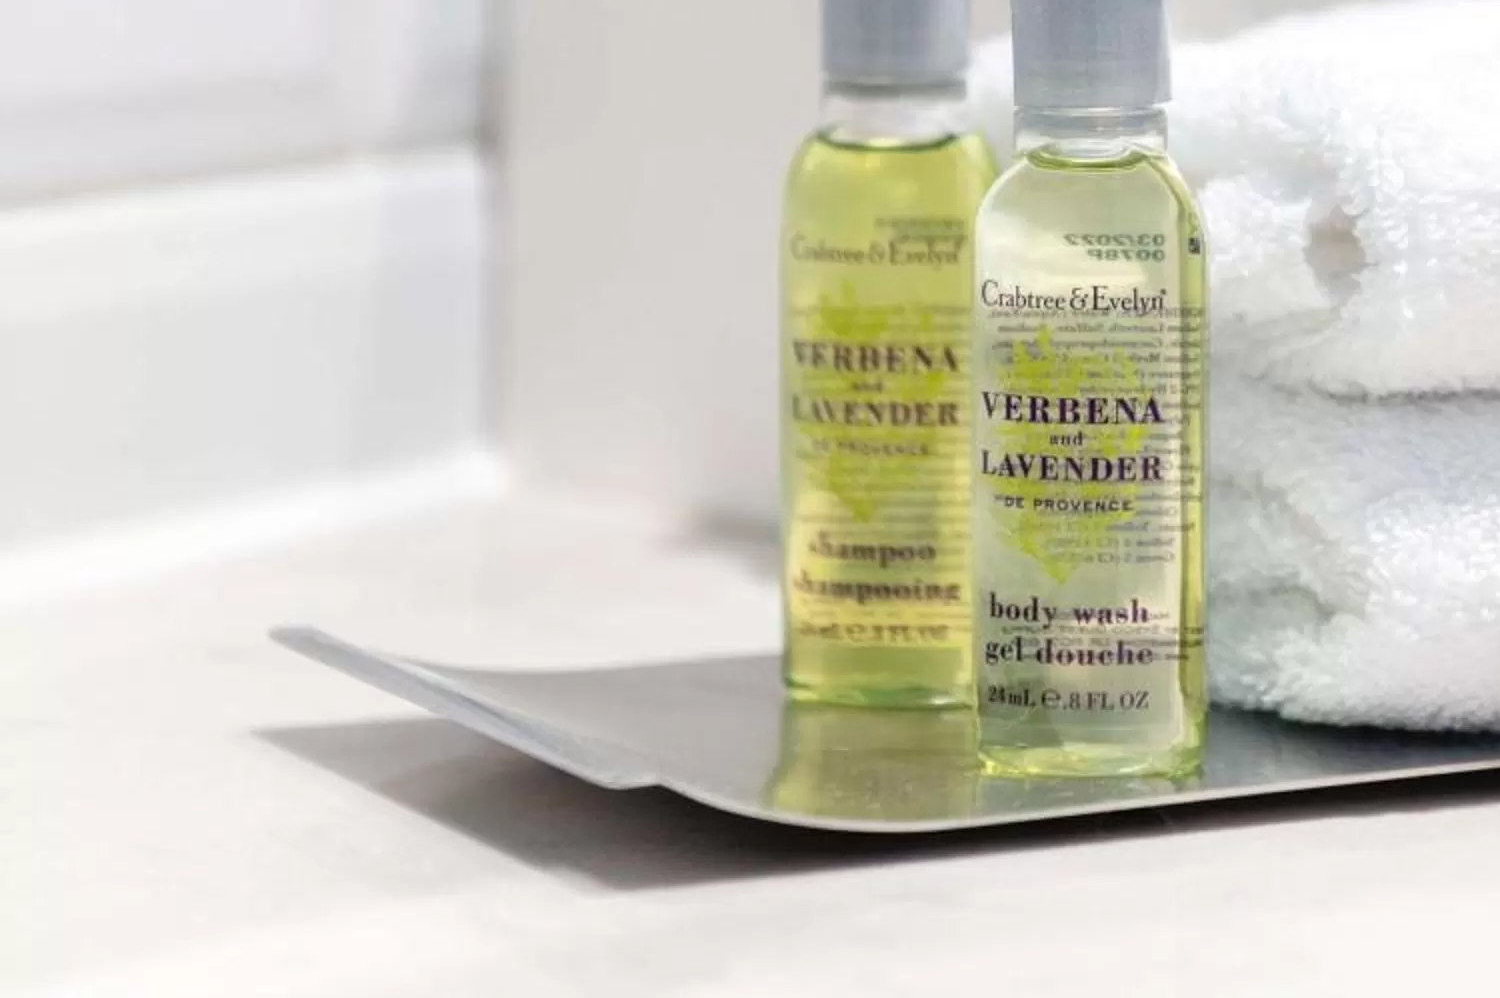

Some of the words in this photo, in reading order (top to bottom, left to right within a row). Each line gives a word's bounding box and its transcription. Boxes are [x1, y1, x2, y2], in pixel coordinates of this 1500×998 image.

[981, 278, 1066, 311] Crabtree
[1069, 286, 1088, 312] &
[1091, 284, 1165, 318] Evelyn
[791, 340, 960, 374] VERBENA
[791, 393, 959, 427] LAVENDER
[981, 390, 1166, 425] VERBENA
[1049, 431, 1083, 447] and
[981, 448, 1163, 484] LAVENDER
[1004, 496, 1025, 510] DE
[1033, 497, 1135, 513] PROVENCE
[989, 590, 1057, 630] body
[1072, 597, 1149, 626] wash
[985, 636, 1024, 665] gel
[1034, 638, 1154, 667] douche
[1119, 690, 1150, 711] OZ
